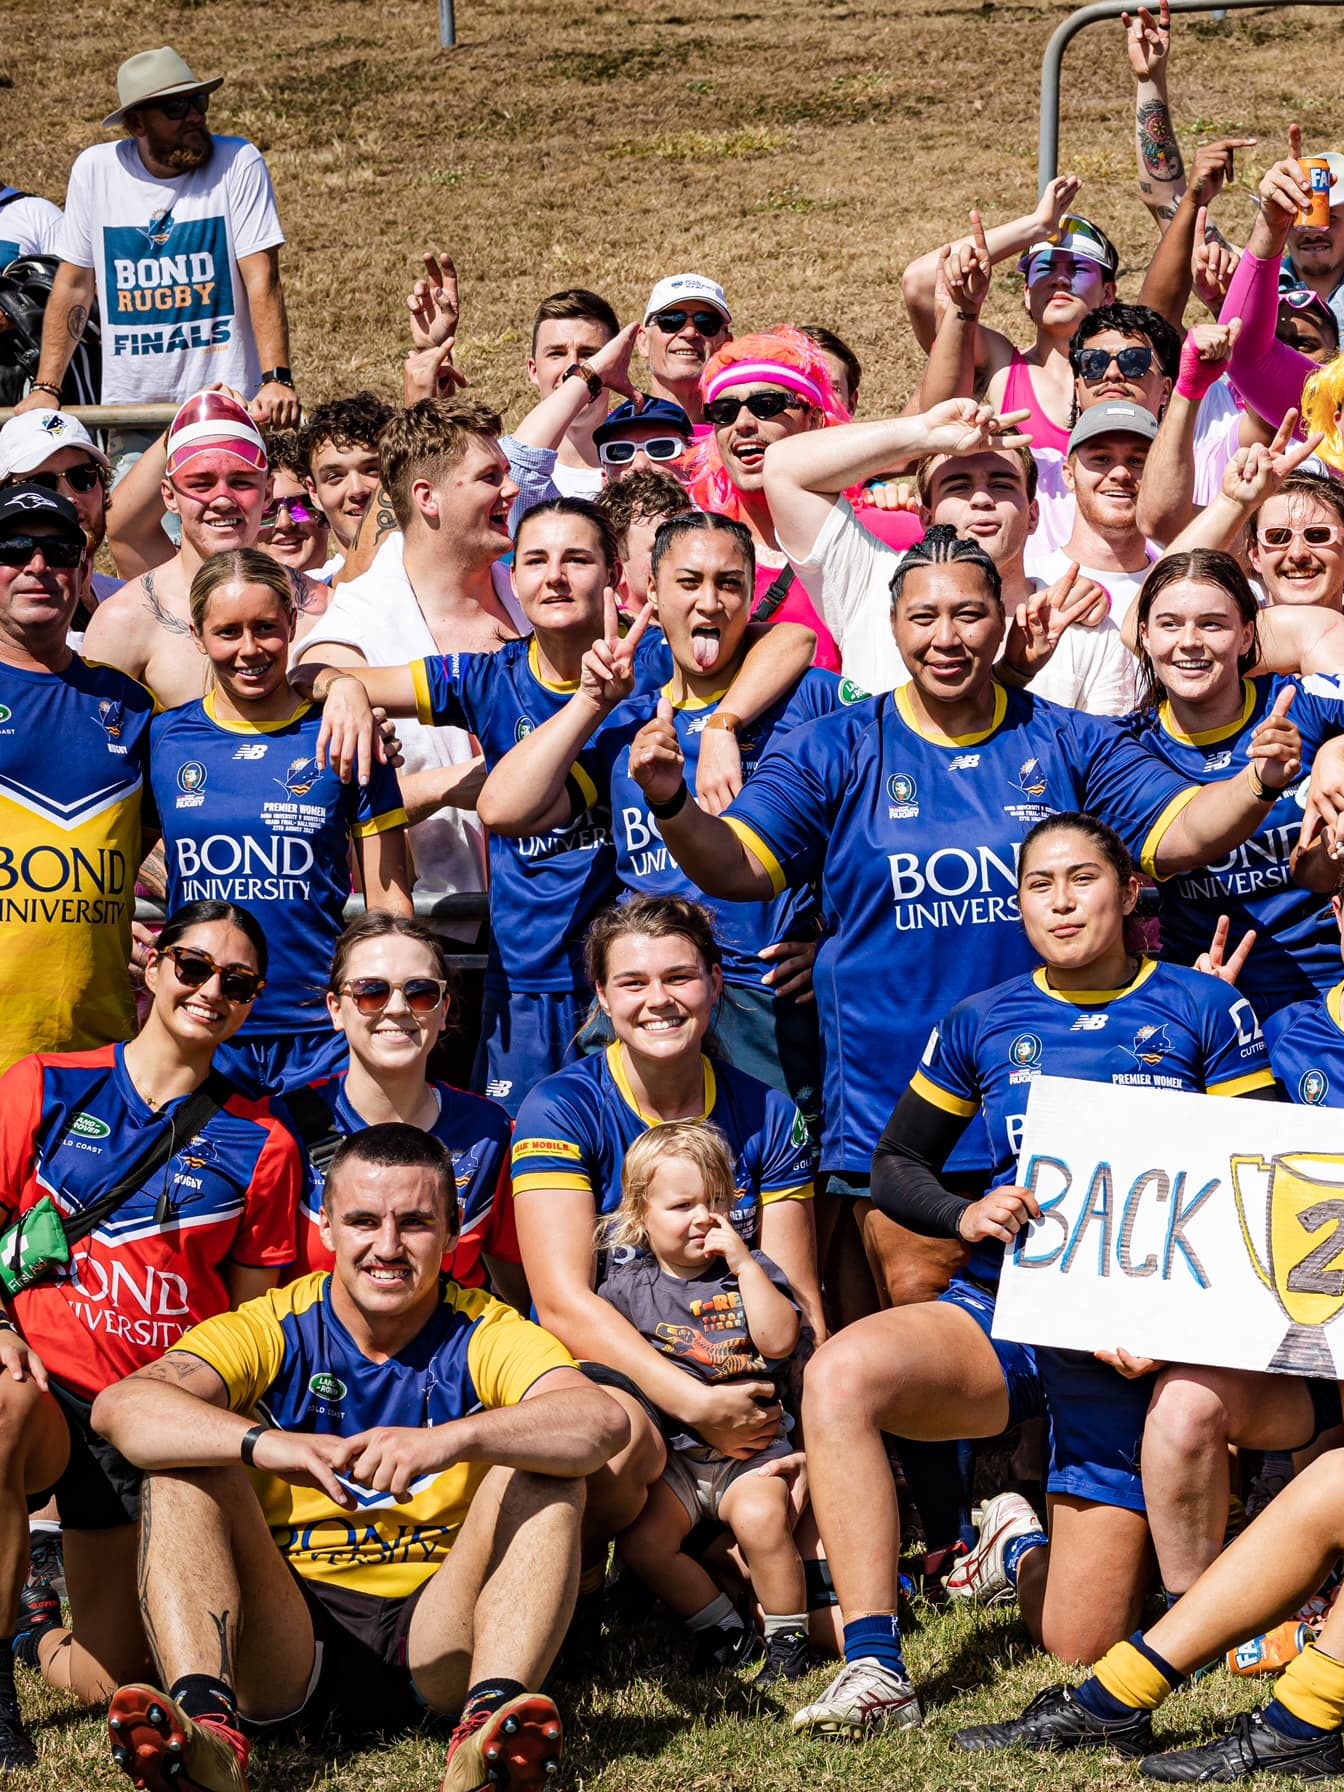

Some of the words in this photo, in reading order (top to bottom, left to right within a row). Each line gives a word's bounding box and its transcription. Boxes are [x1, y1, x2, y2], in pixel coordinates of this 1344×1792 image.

[114, 251, 215, 289] BOND
[117, 282, 215, 312] RUGBY
[114, 319, 232, 356] FINALS
[263, 802, 297, 813] PREMIER
[299, 804, 326, 817] WOMEN
[175, 835, 314, 878] BOND
[887, 843, 1022, 900] BON
[182, 878, 312, 902] UNIVERSITY
[1177, 865, 1290, 900] UNIVERSI
[895, 894, 1023, 931] UNIVERS
[1112, 1073, 1151, 1085] PREMIER
[1153, 1075, 1183, 1089] WOMEN
[75, 1142, 103, 1155] COAST
[1012, 1155, 1222, 1290] BACK
[8, 1270, 34, 1292] First
[29, 1256, 48, 1275] Aid
[55, 1252, 191, 1316] OND
